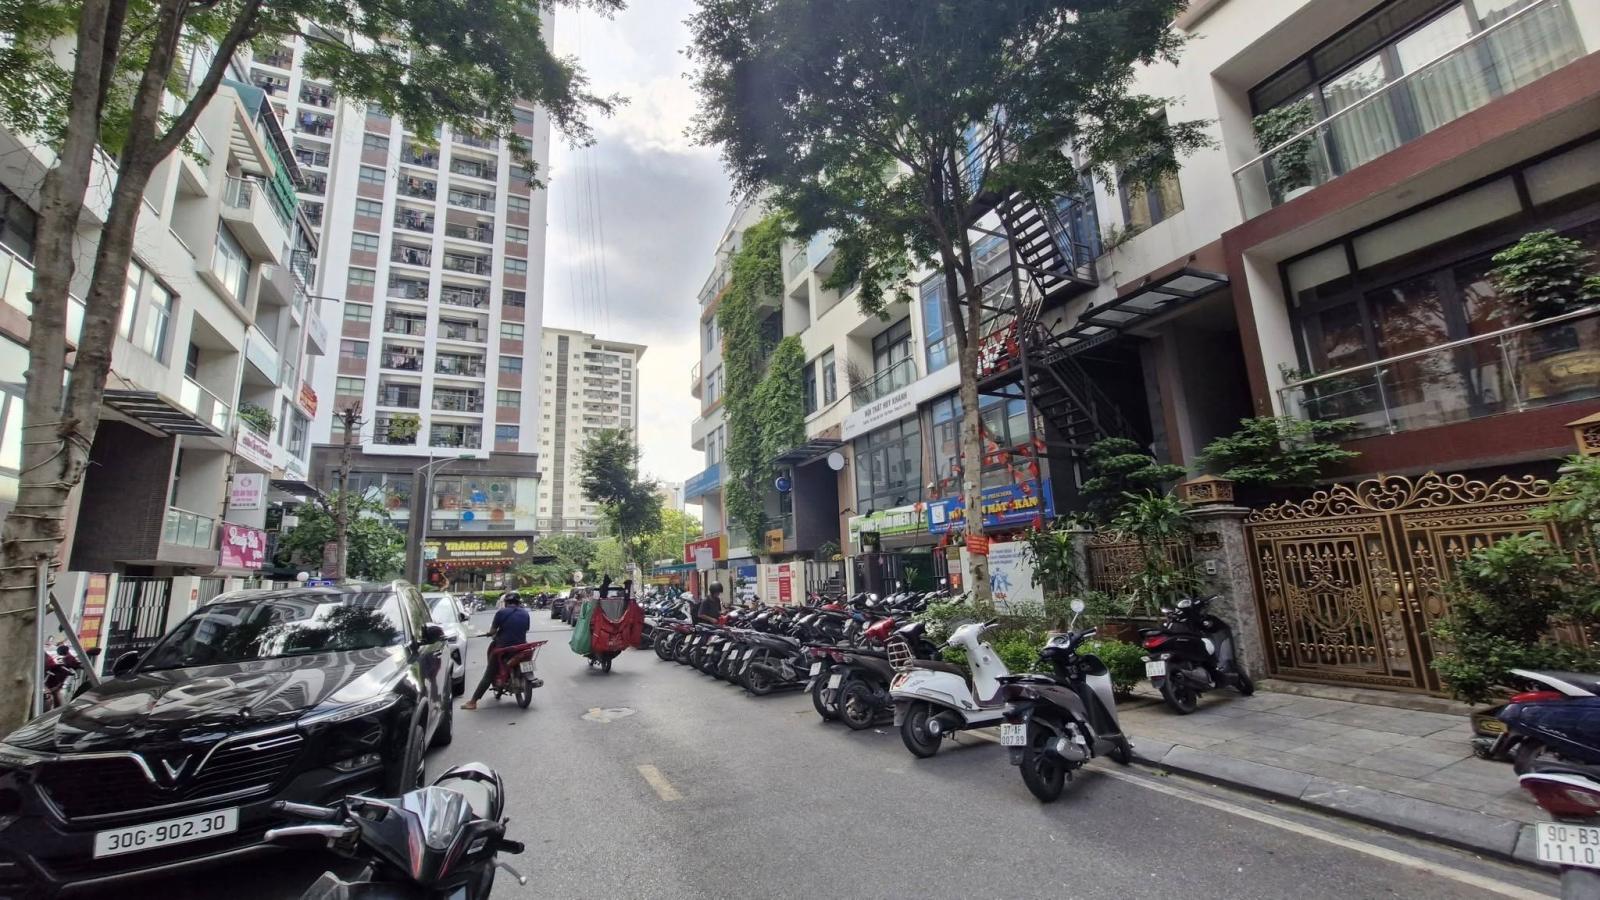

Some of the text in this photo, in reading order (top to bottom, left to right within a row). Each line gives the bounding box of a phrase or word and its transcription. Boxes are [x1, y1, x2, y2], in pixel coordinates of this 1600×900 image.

[107, 815, 226, 850] 30G-902.30
[1547, 825, 1599, 845] 90-B3
[1544, 843, 1600, 864] 111.0
